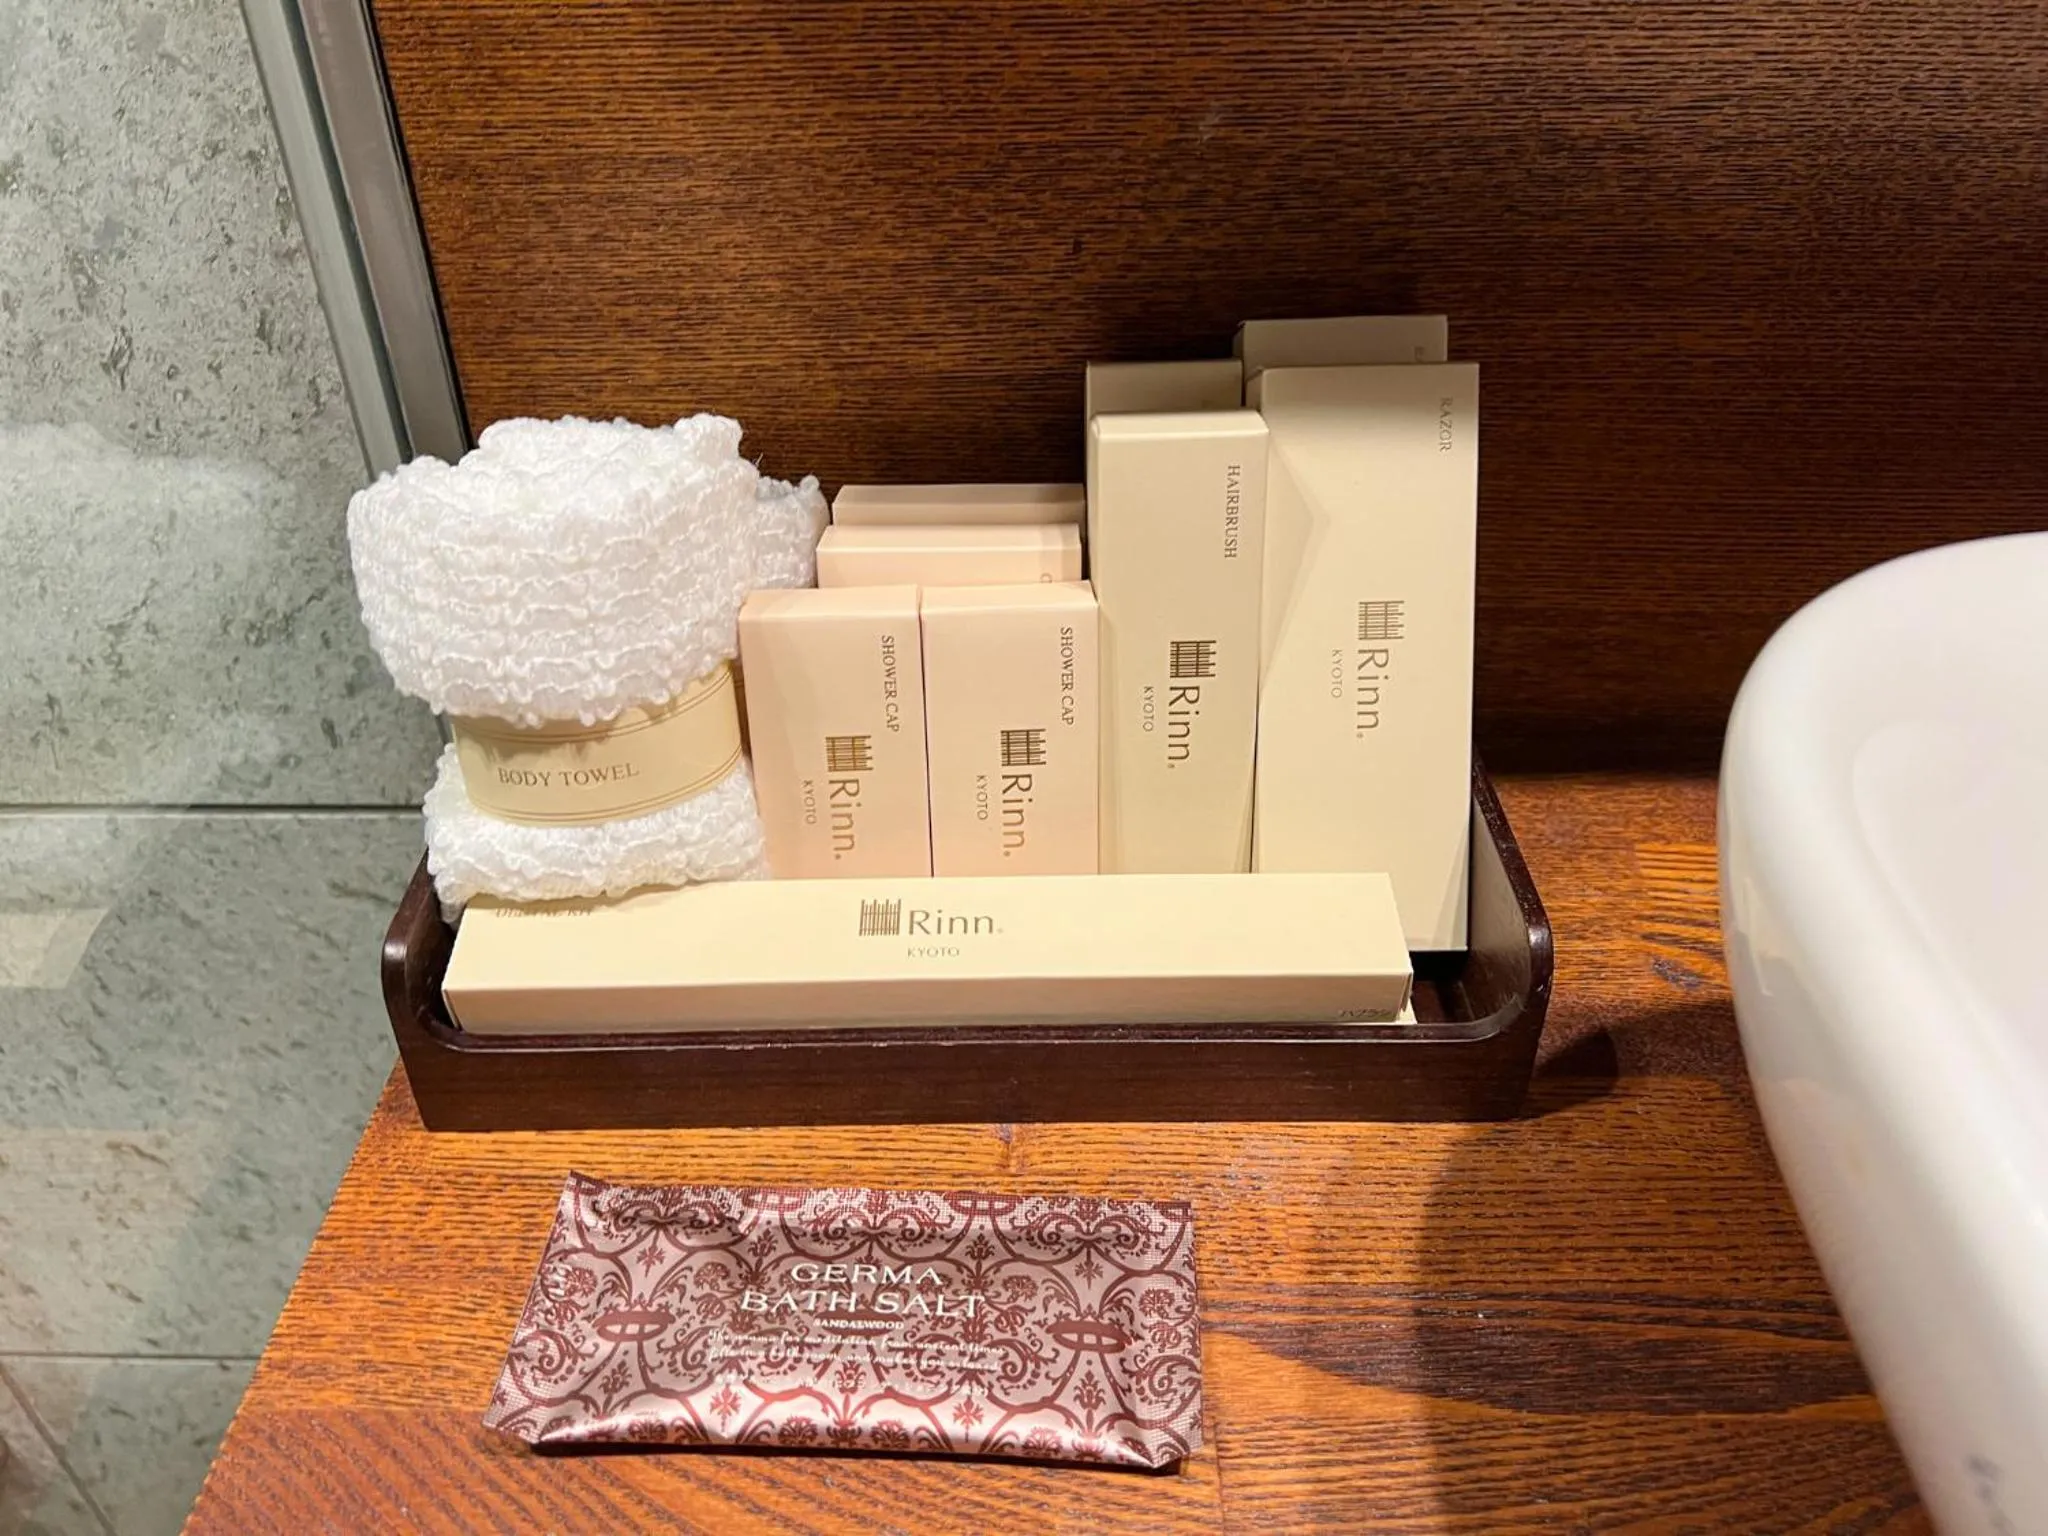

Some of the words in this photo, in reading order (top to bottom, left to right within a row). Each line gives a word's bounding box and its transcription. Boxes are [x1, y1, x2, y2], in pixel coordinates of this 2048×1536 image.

[1439, 397, 1453, 452] RAZOR
[1224, 465, 1240, 558] HAIRBRUSH
[881, 635, 897, 699] SHOWER
[1060, 627, 1074, 691] SHOWER
[1331, 649, 1342, 698] KYOTO
[886, 702, 899, 732] CAP
[1061, 695, 1074, 725] CAP
[1142, 686, 1154, 732] KYOTO
[497, 767, 551, 786] BODY
[558, 762, 640, 786] TOWEL
[802, 780, 817, 824] KYOTO
[976, 775, 988, 820] KYOTO
[907, 947, 961, 958] KYOTO
[790, 1263, 944, 1285] GERMA
[741, 1290, 858, 1313] BATH
[873, 1292, 986, 1319] SALT
[813, 1319, 905, 1330] SANDALWOOD
